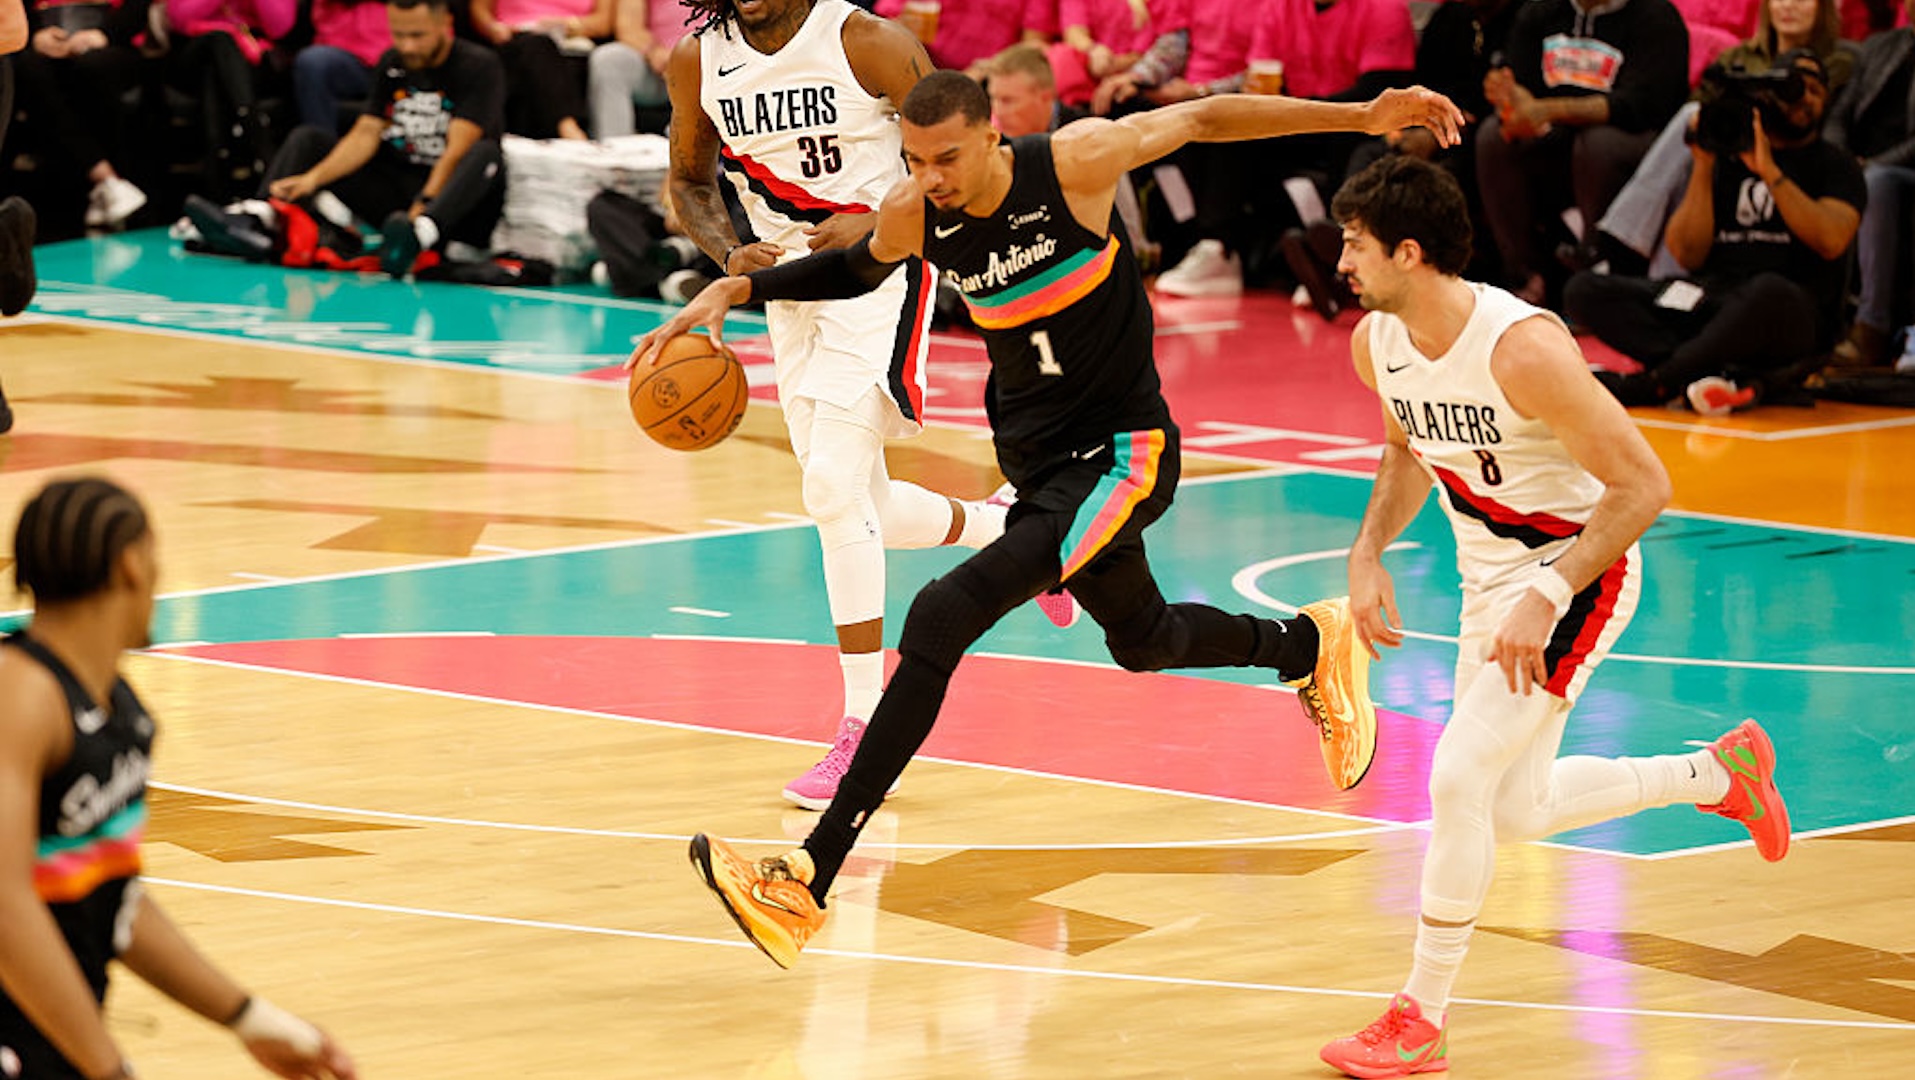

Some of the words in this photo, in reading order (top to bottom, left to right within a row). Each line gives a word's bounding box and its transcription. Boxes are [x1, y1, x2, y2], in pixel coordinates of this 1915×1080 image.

[718, 86, 837, 136] BLAZERS
[797, 135, 842, 178] 35
[982, 233, 1057, 288] Antonio
[1029, 330, 1064, 376] 1
[1390, 397, 1502, 445] BLAZERS
[1472, 449, 1502, 486] 8
